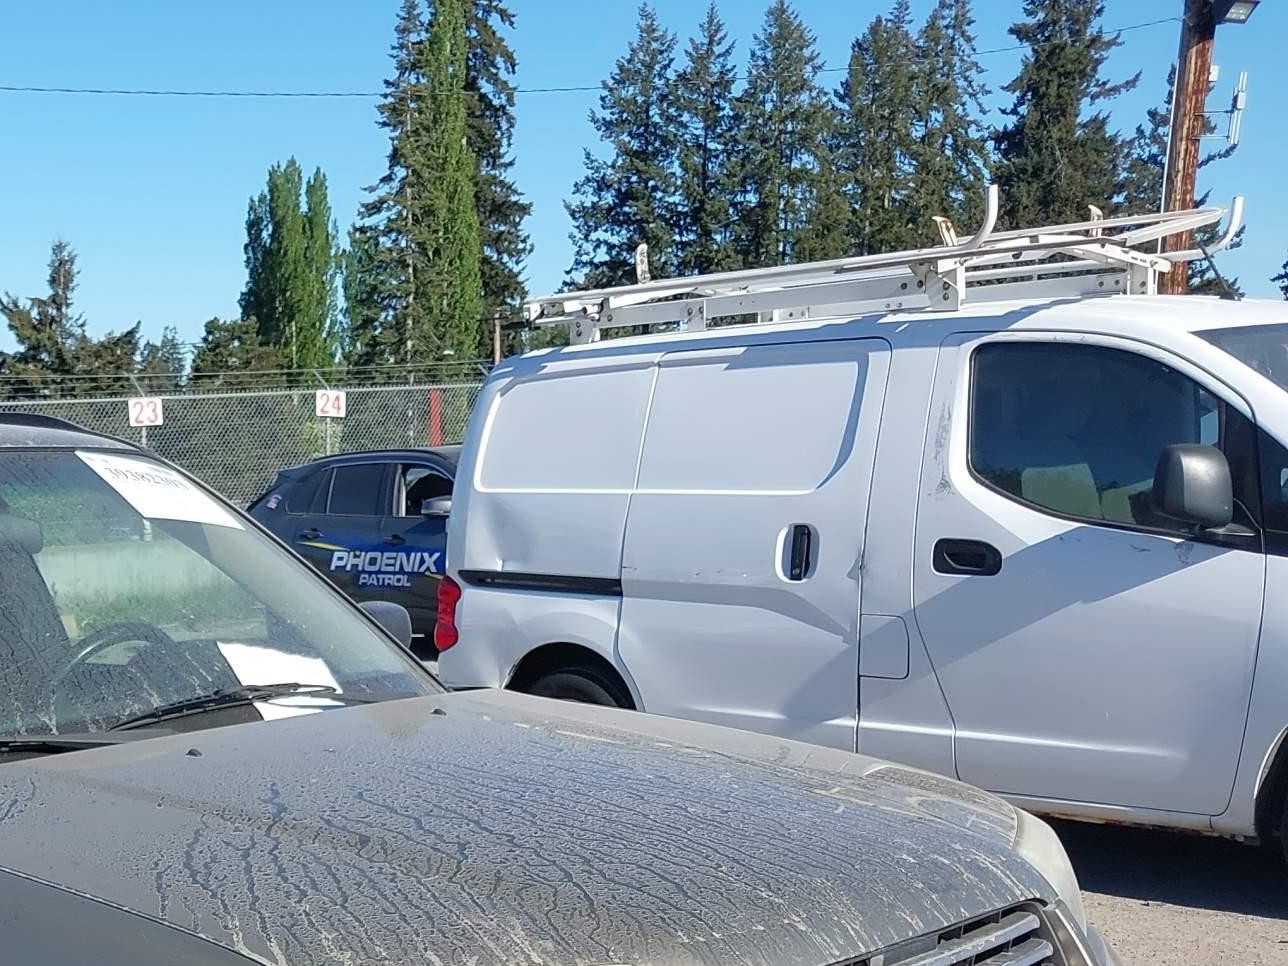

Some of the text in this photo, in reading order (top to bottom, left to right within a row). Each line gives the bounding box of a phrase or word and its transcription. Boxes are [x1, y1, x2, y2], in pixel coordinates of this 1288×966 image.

[132, 401, 158, 423] 23
[320, 392, 342, 415] 24
[330, 551, 441, 573] PHOENIX
[359, 574, 412, 587] PATROL
